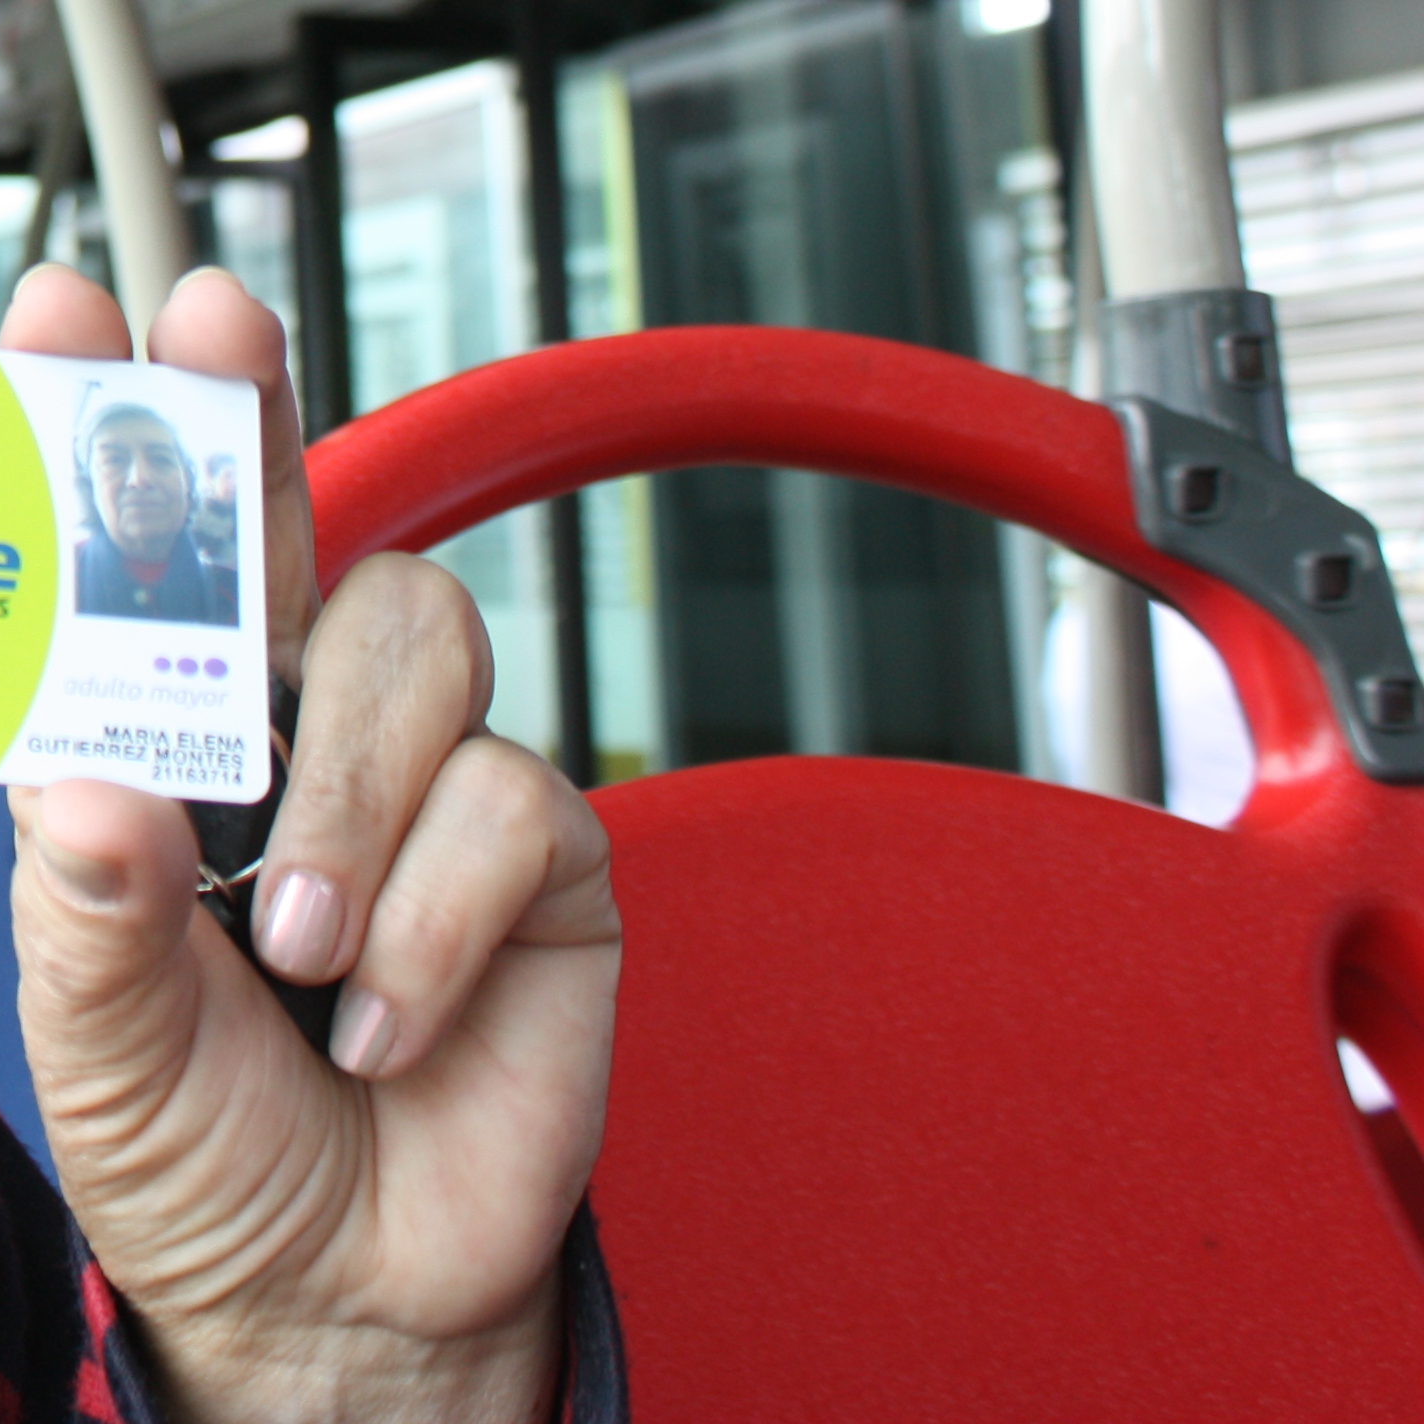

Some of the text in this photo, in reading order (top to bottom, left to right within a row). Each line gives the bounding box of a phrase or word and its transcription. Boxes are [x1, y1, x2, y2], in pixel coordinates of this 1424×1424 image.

[64, 676, 230, 711] adulto mayor
[27, 737, 243, 770] GUTIERREZ MONTES
[103, 726, 245, 752] MARIA ELENA
